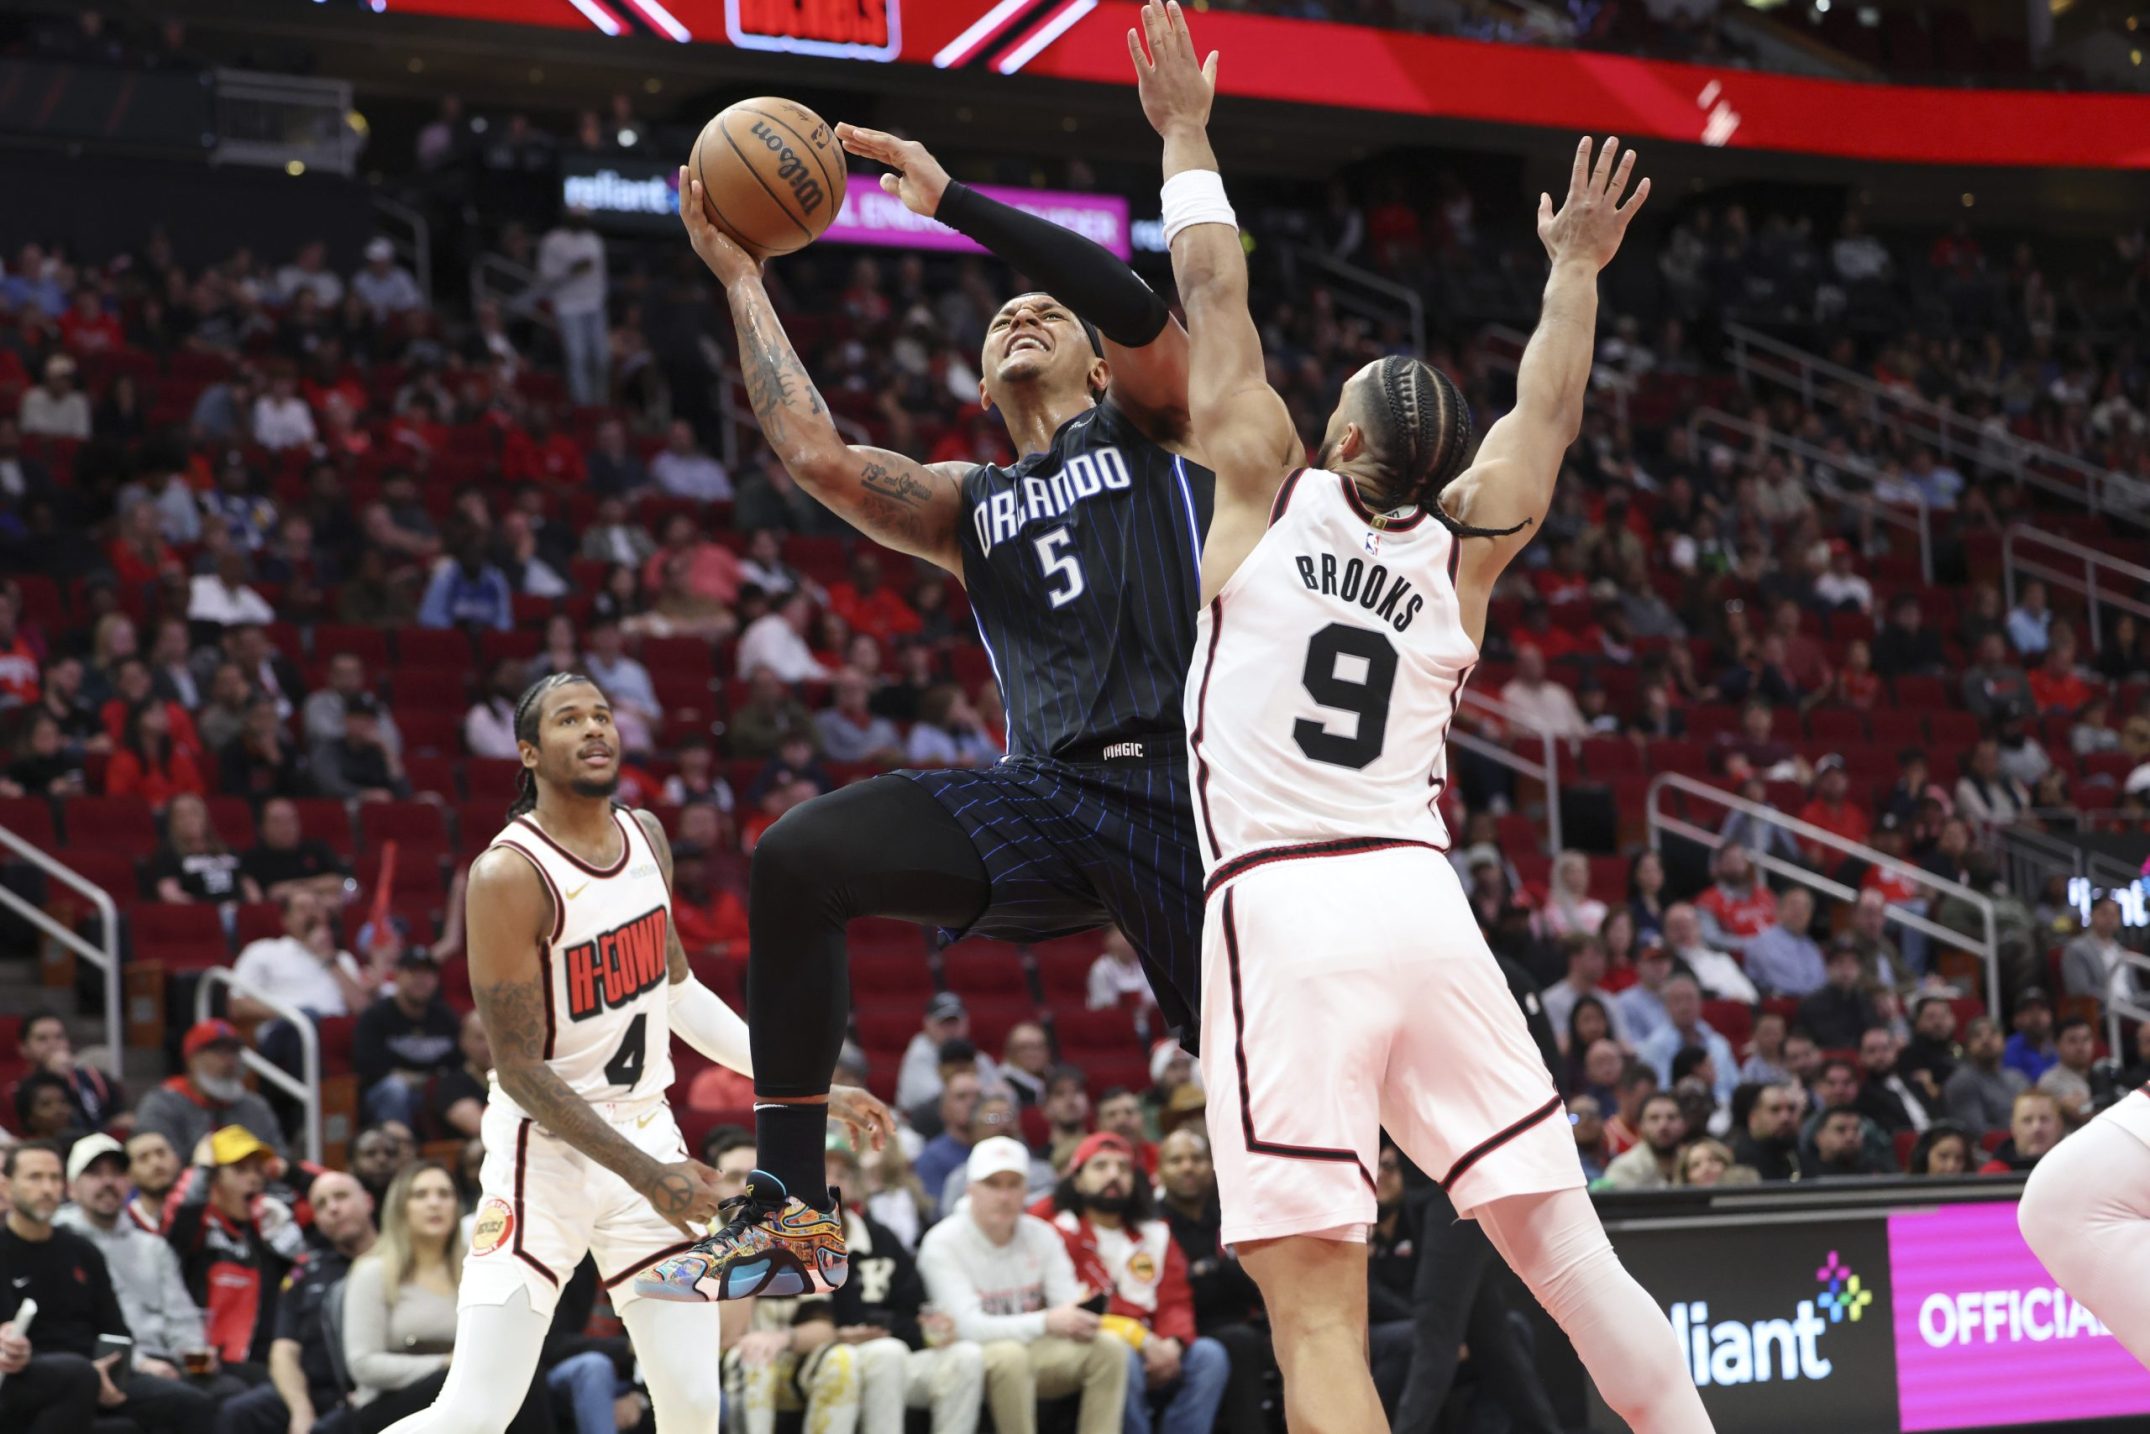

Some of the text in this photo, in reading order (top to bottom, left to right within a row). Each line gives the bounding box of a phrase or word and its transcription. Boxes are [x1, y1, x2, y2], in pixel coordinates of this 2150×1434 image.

[750, 121, 825, 216] Wilson
[973, 446, 1132, 560] ORLANDO
[1033, 525, 1085, 609] 5
[1295, 552, 1424, 633] BROOKS
[1290, 621, 1400, 771] 9
[1103, 742, 1144, 761] MAGIC
[603, 1012, 648, 1093] 4
